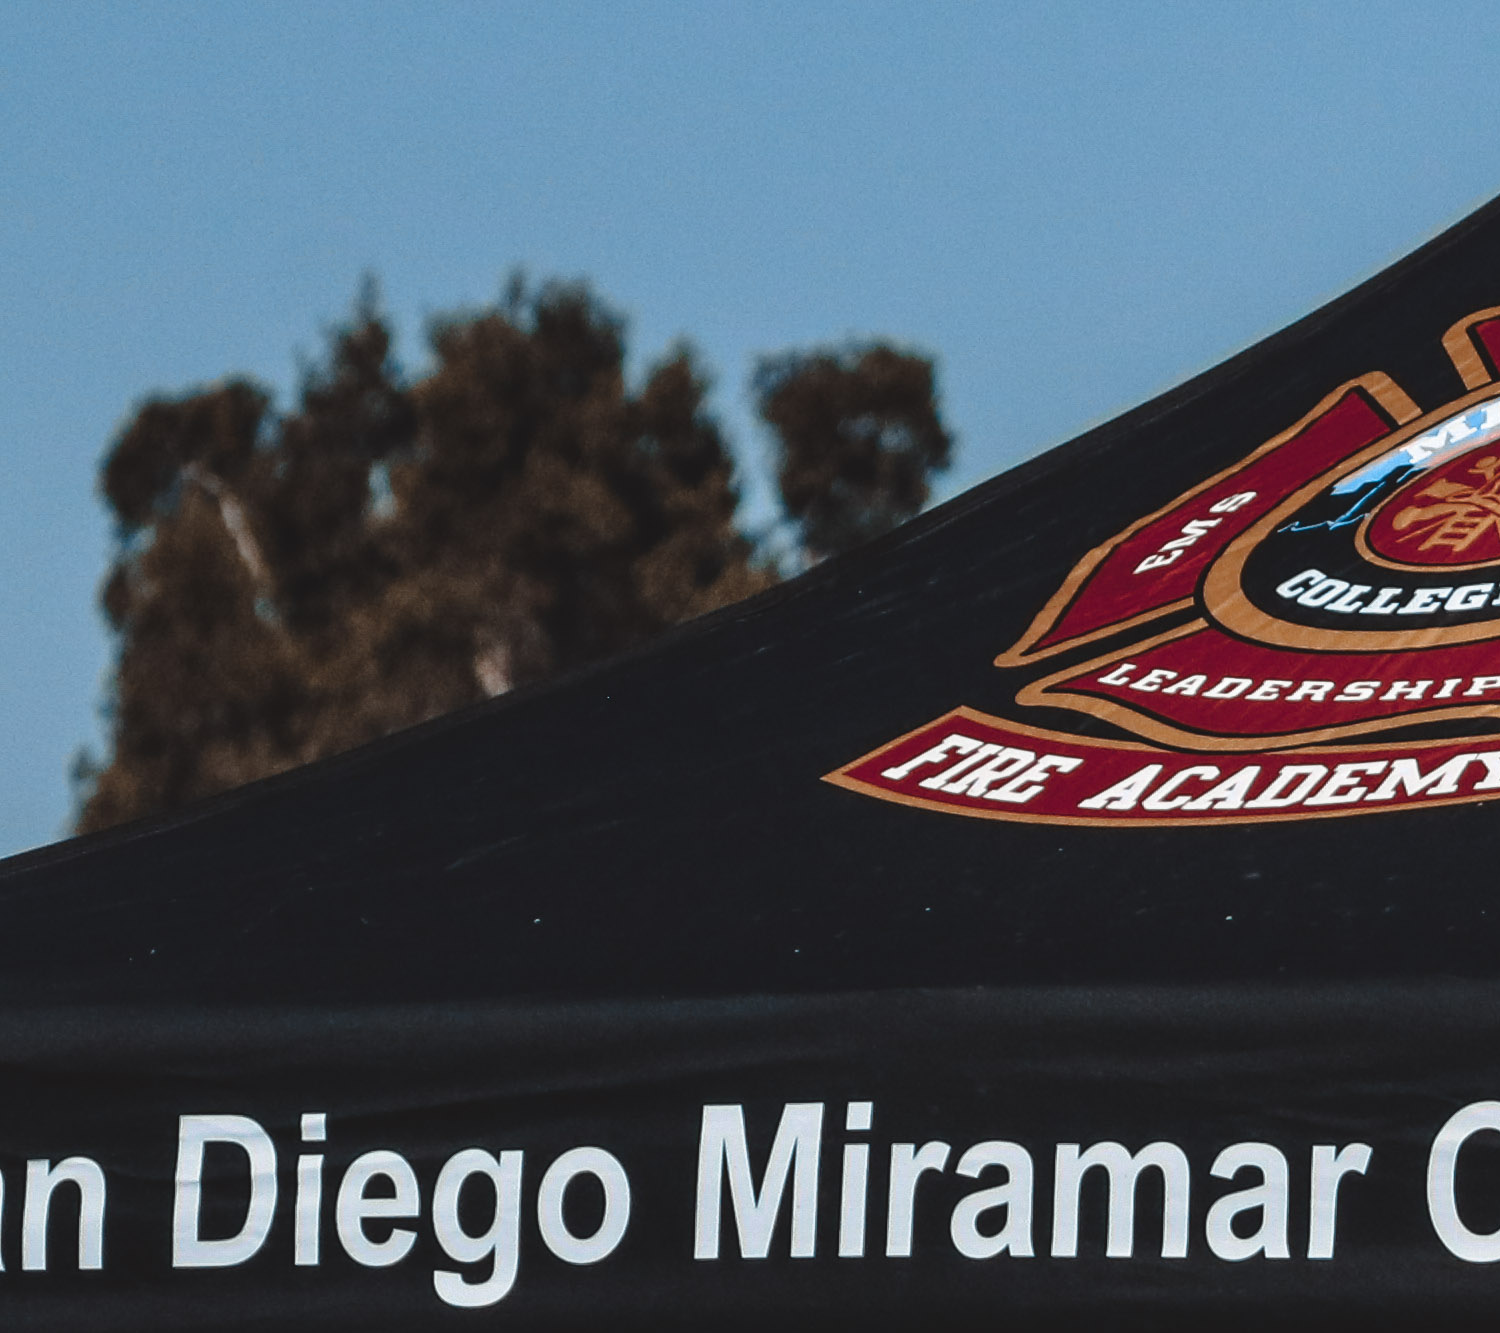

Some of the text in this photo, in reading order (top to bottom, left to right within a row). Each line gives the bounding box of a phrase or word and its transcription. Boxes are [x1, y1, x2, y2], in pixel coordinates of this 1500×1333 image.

[1132, 488, 1253, 578] EMS
[881, 732, 1083, 803] FIRE
[172, 1112, 633, 1309] Diego
[693, 1101, 1374, 1262] Miramar
